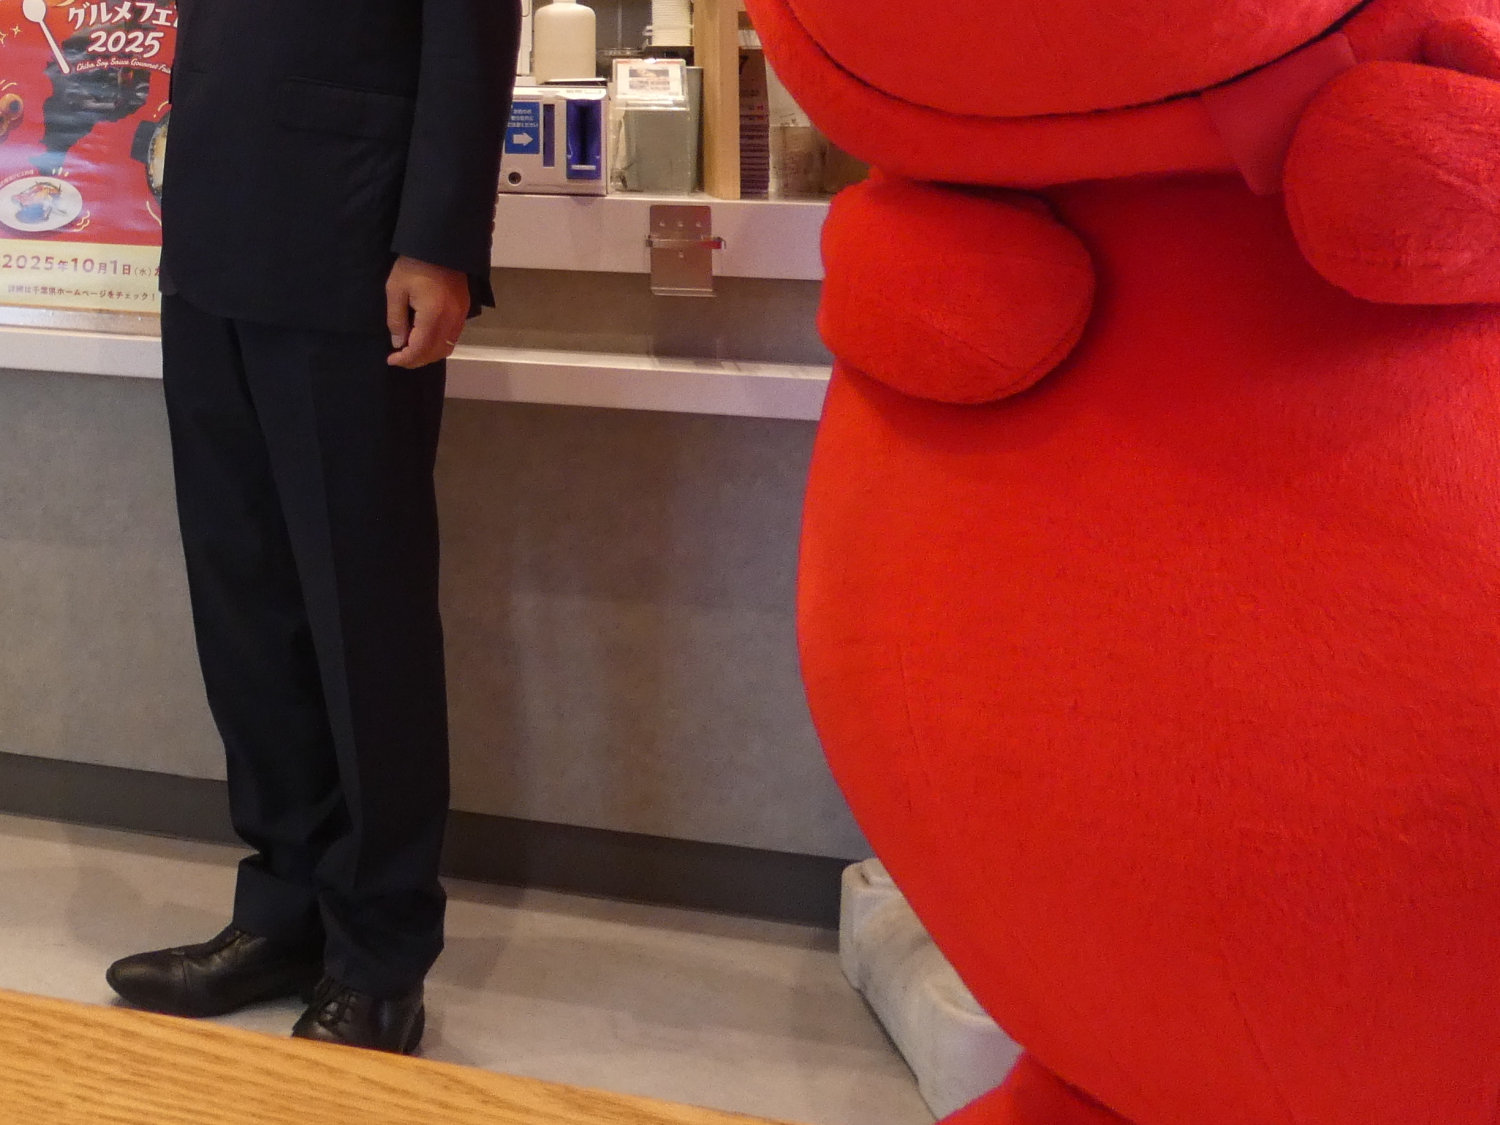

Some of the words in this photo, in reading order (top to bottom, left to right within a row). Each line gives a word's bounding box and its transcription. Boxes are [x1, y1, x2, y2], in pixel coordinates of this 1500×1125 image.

[68, 1, 178, 30] グルメフェ
[88, 30, 164, 58] 2025
[76, 61, 95, 72] Chiba
[96, 58, 109, 69] Soy
[110, 57, 130, 65] Sauce
[130, 58, 159, 70] Gourmet
